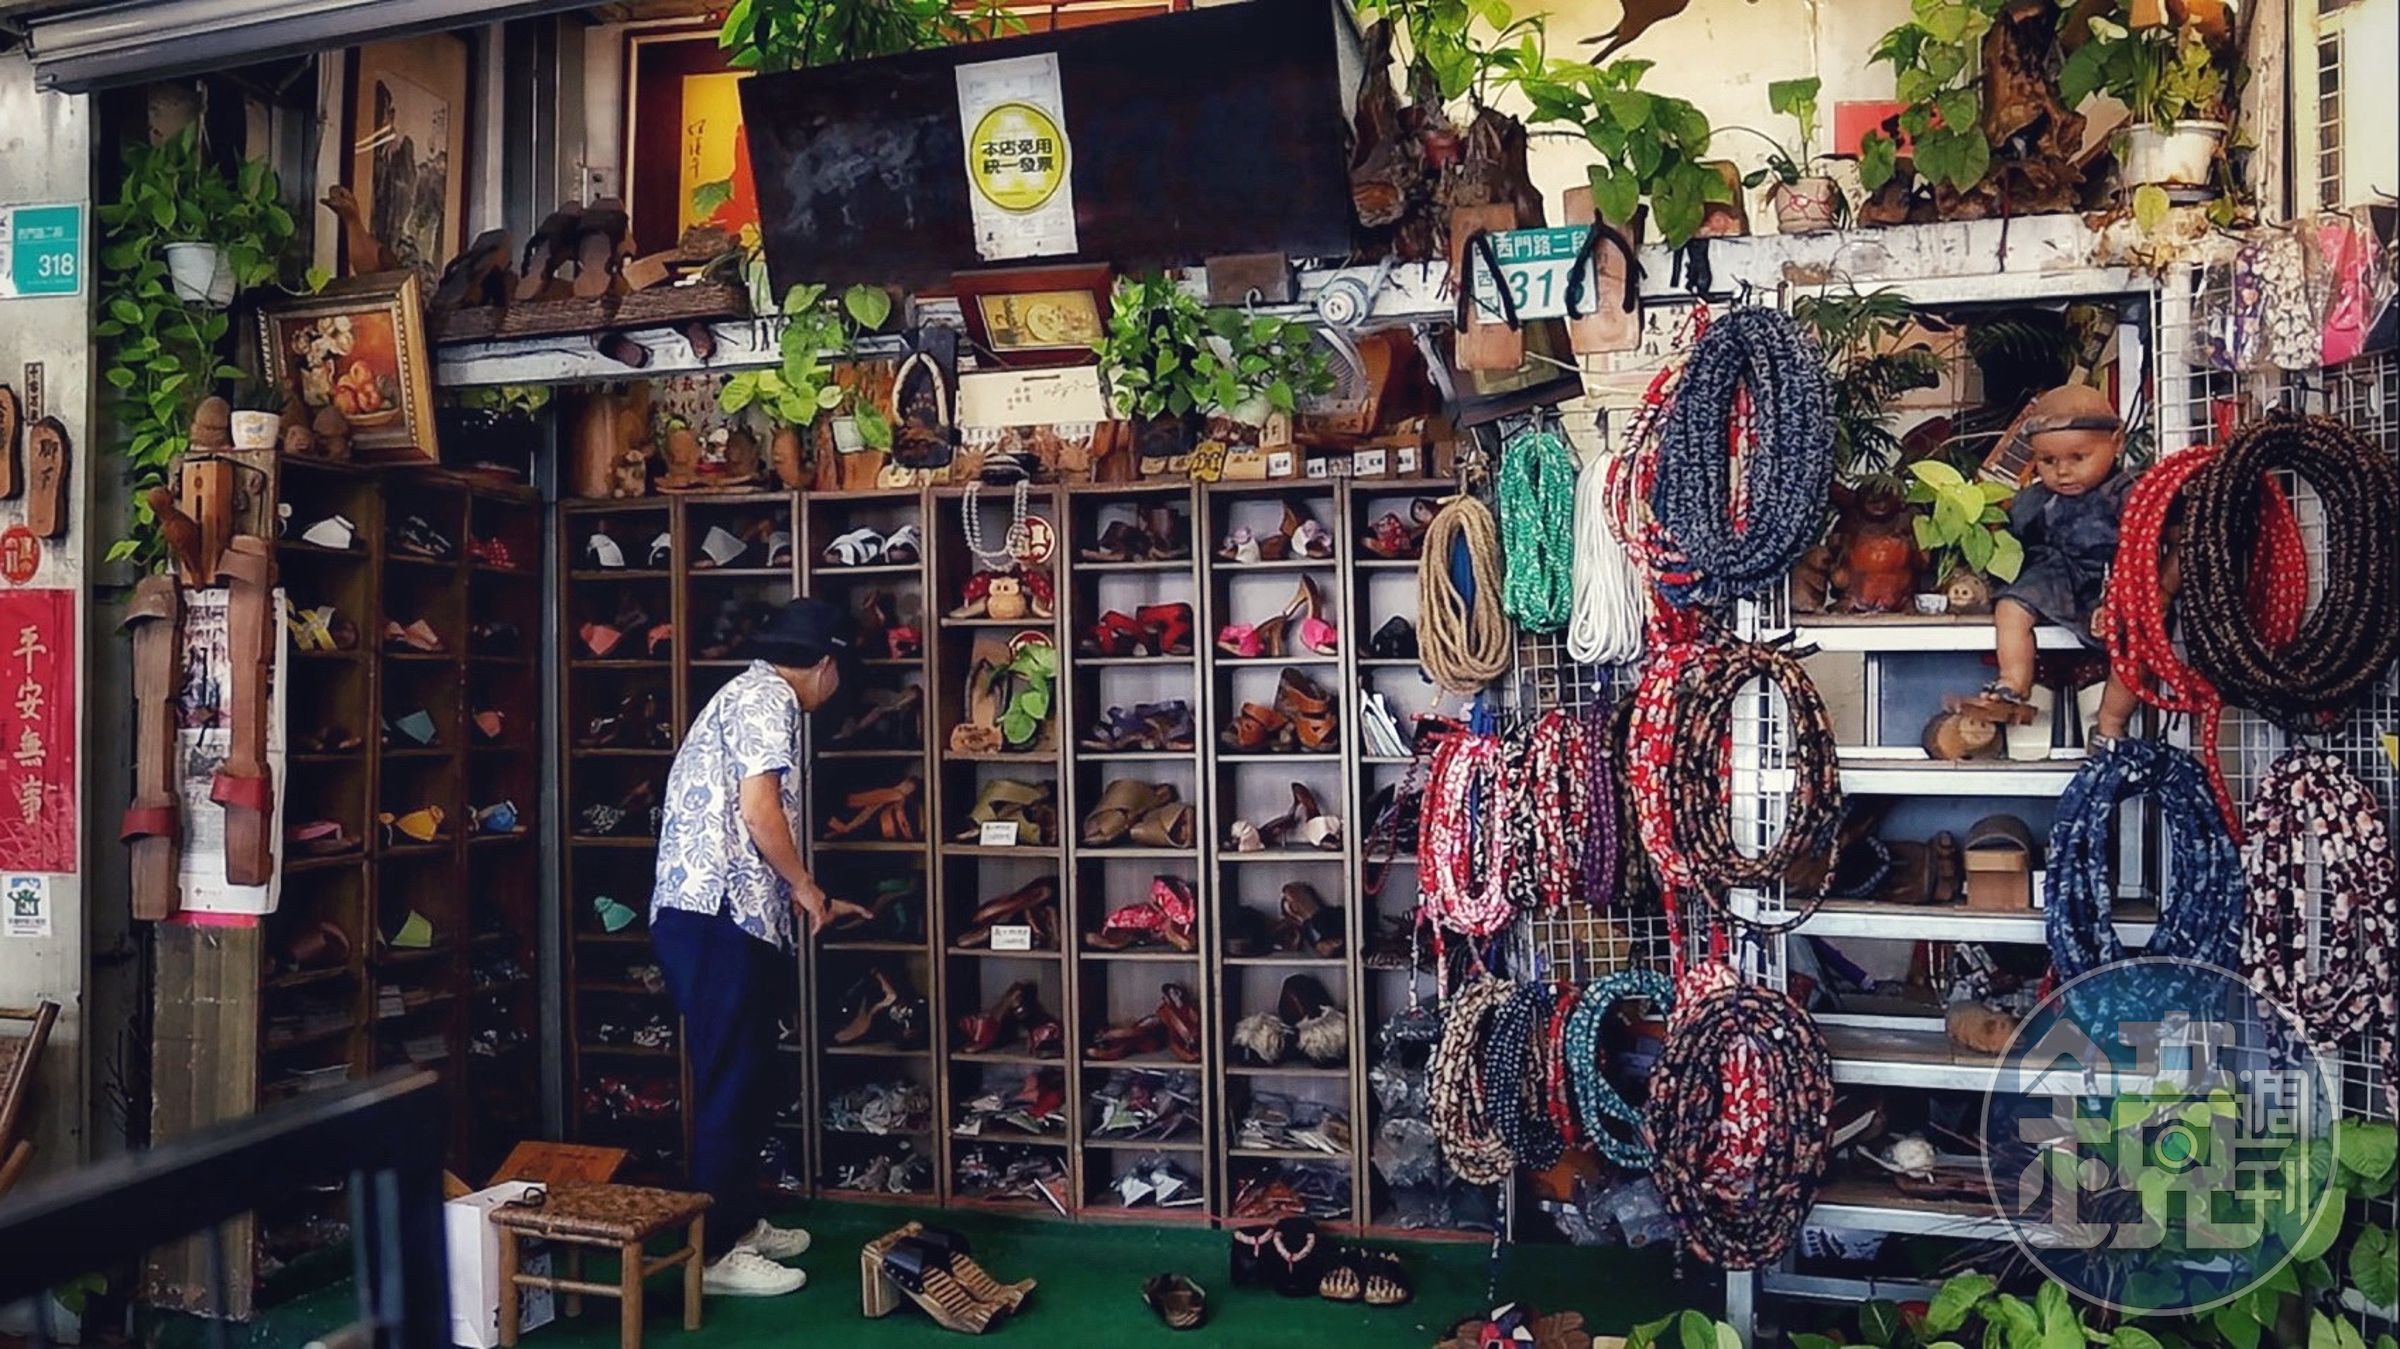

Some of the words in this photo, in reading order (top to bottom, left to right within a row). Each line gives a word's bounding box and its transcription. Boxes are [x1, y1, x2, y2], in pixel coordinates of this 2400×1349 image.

[981, 138, 1053, 157] 本店免用
[983, 156, 1054, 175] 統一發票
[1494, 230, 1590, 259] 西門路二段
[38, 252, 75, 277] 318
[13, 623, 47, 825] 平安無事
